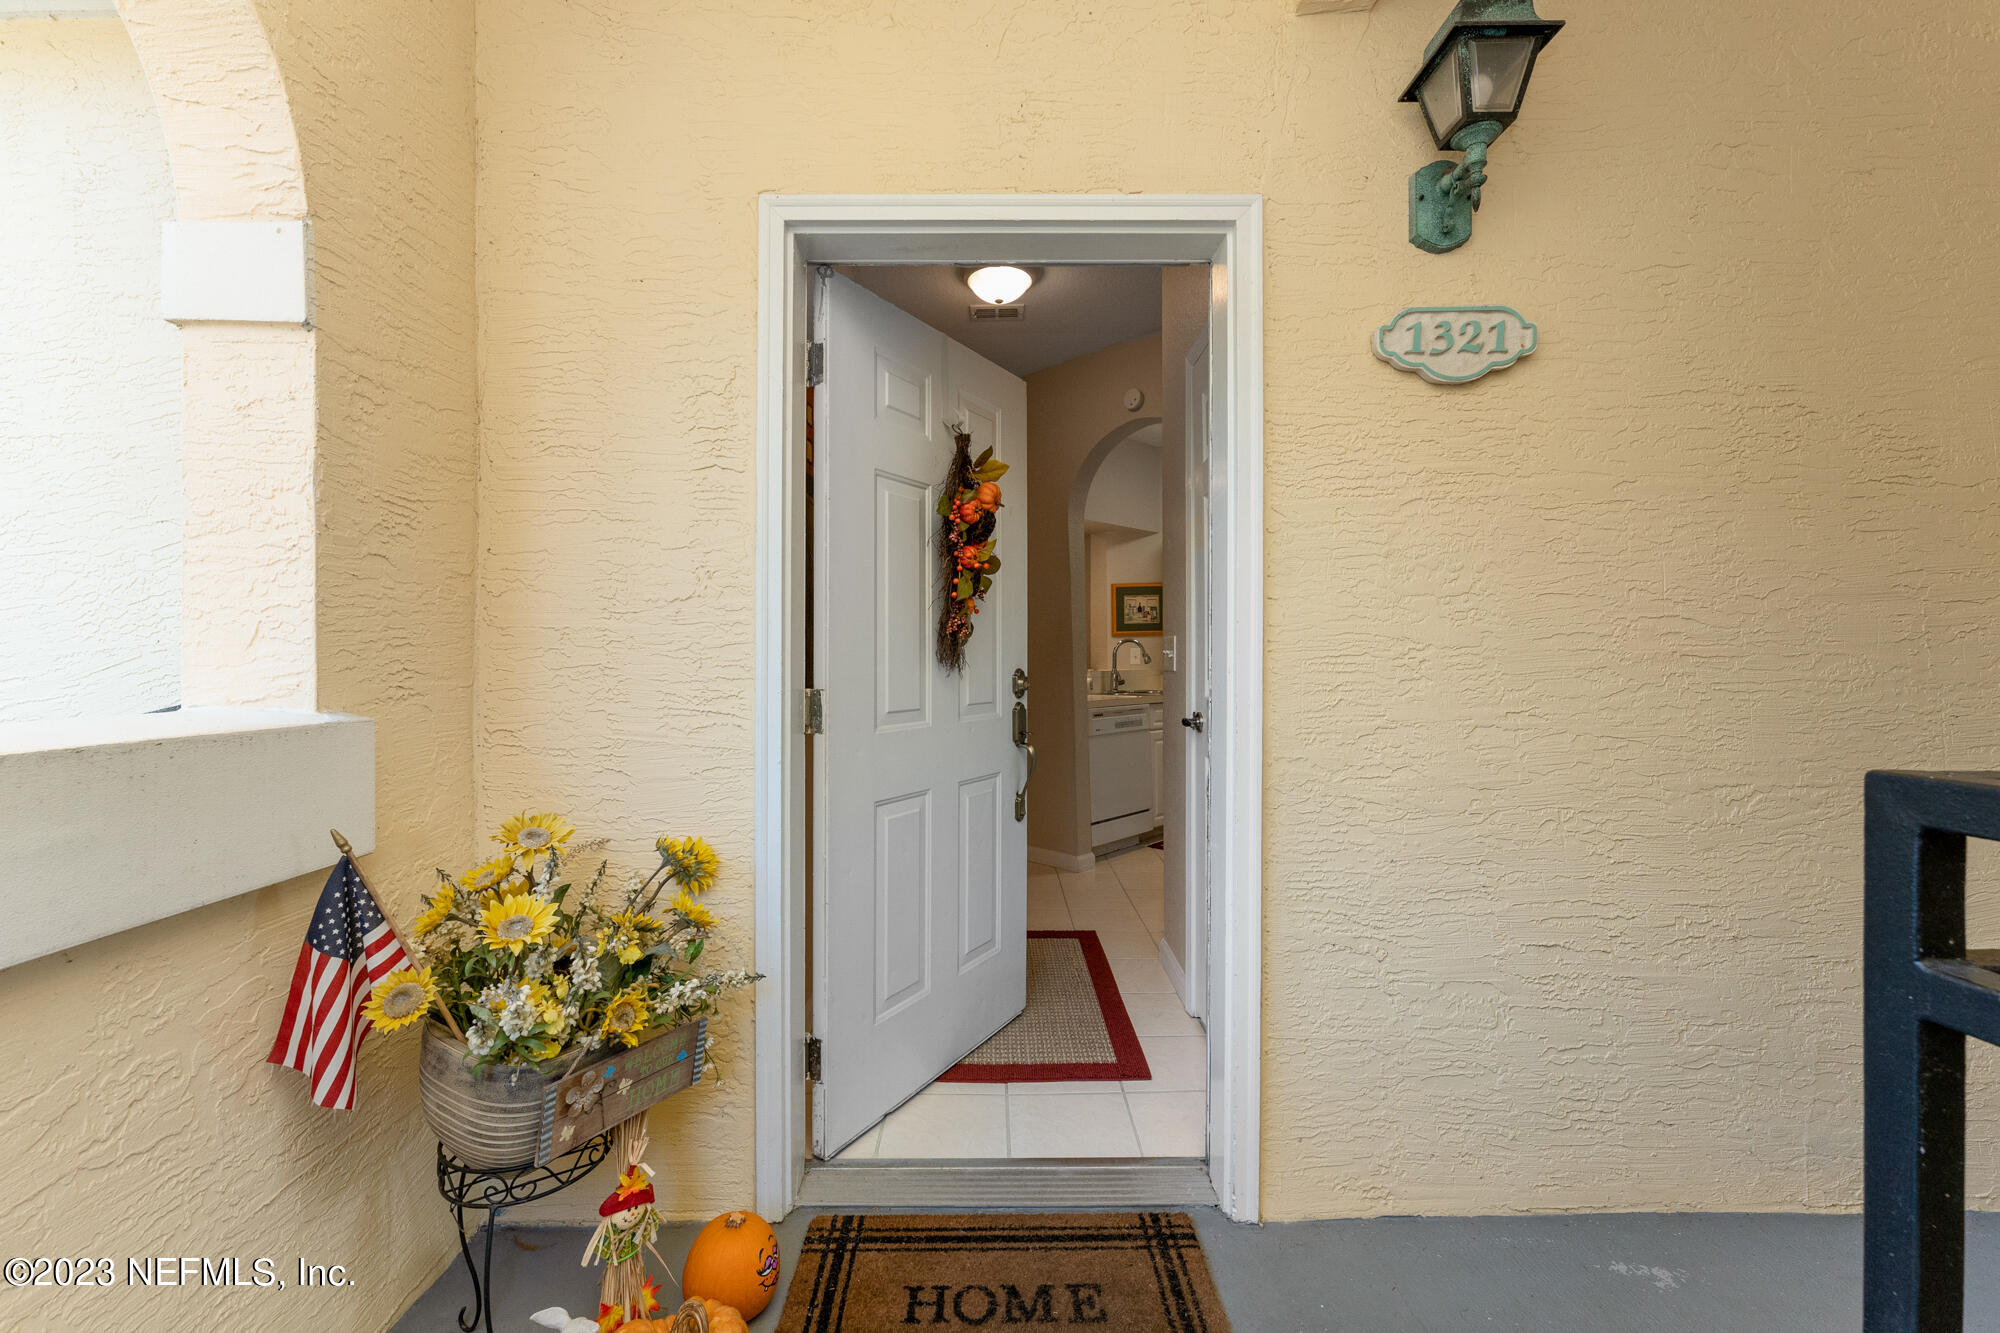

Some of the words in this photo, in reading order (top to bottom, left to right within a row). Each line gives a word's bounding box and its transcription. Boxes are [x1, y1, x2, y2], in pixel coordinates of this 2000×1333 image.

[1404, 320, 1509, 356] 1321
[628, 1066, 682, 1109] HOME
[900, 1283, 1108, 1326] HOME
